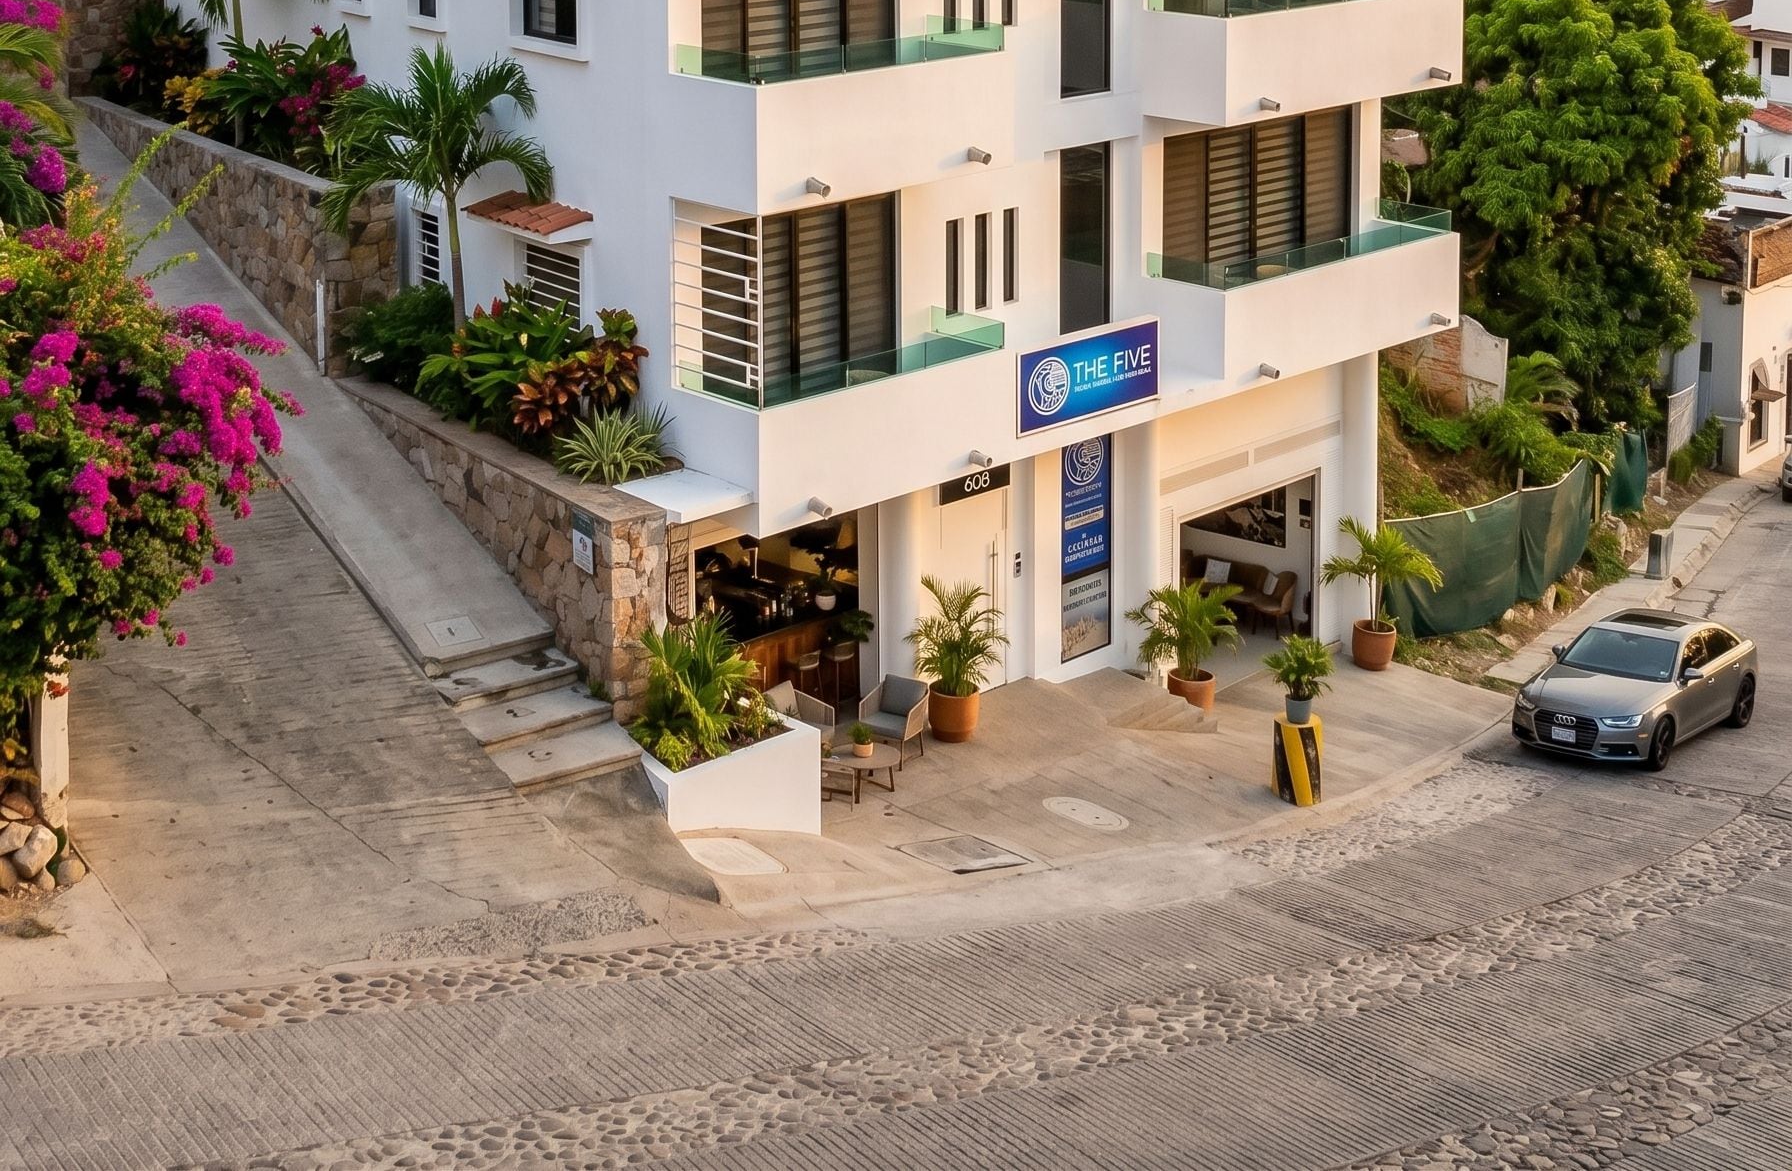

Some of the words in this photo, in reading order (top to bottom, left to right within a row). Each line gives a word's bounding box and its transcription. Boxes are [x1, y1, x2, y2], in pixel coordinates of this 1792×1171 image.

[1073, 355, 1108, 383] THE
[1114, 344, 1151, 374] FIVE
[964, 471, 990, 492] 608
